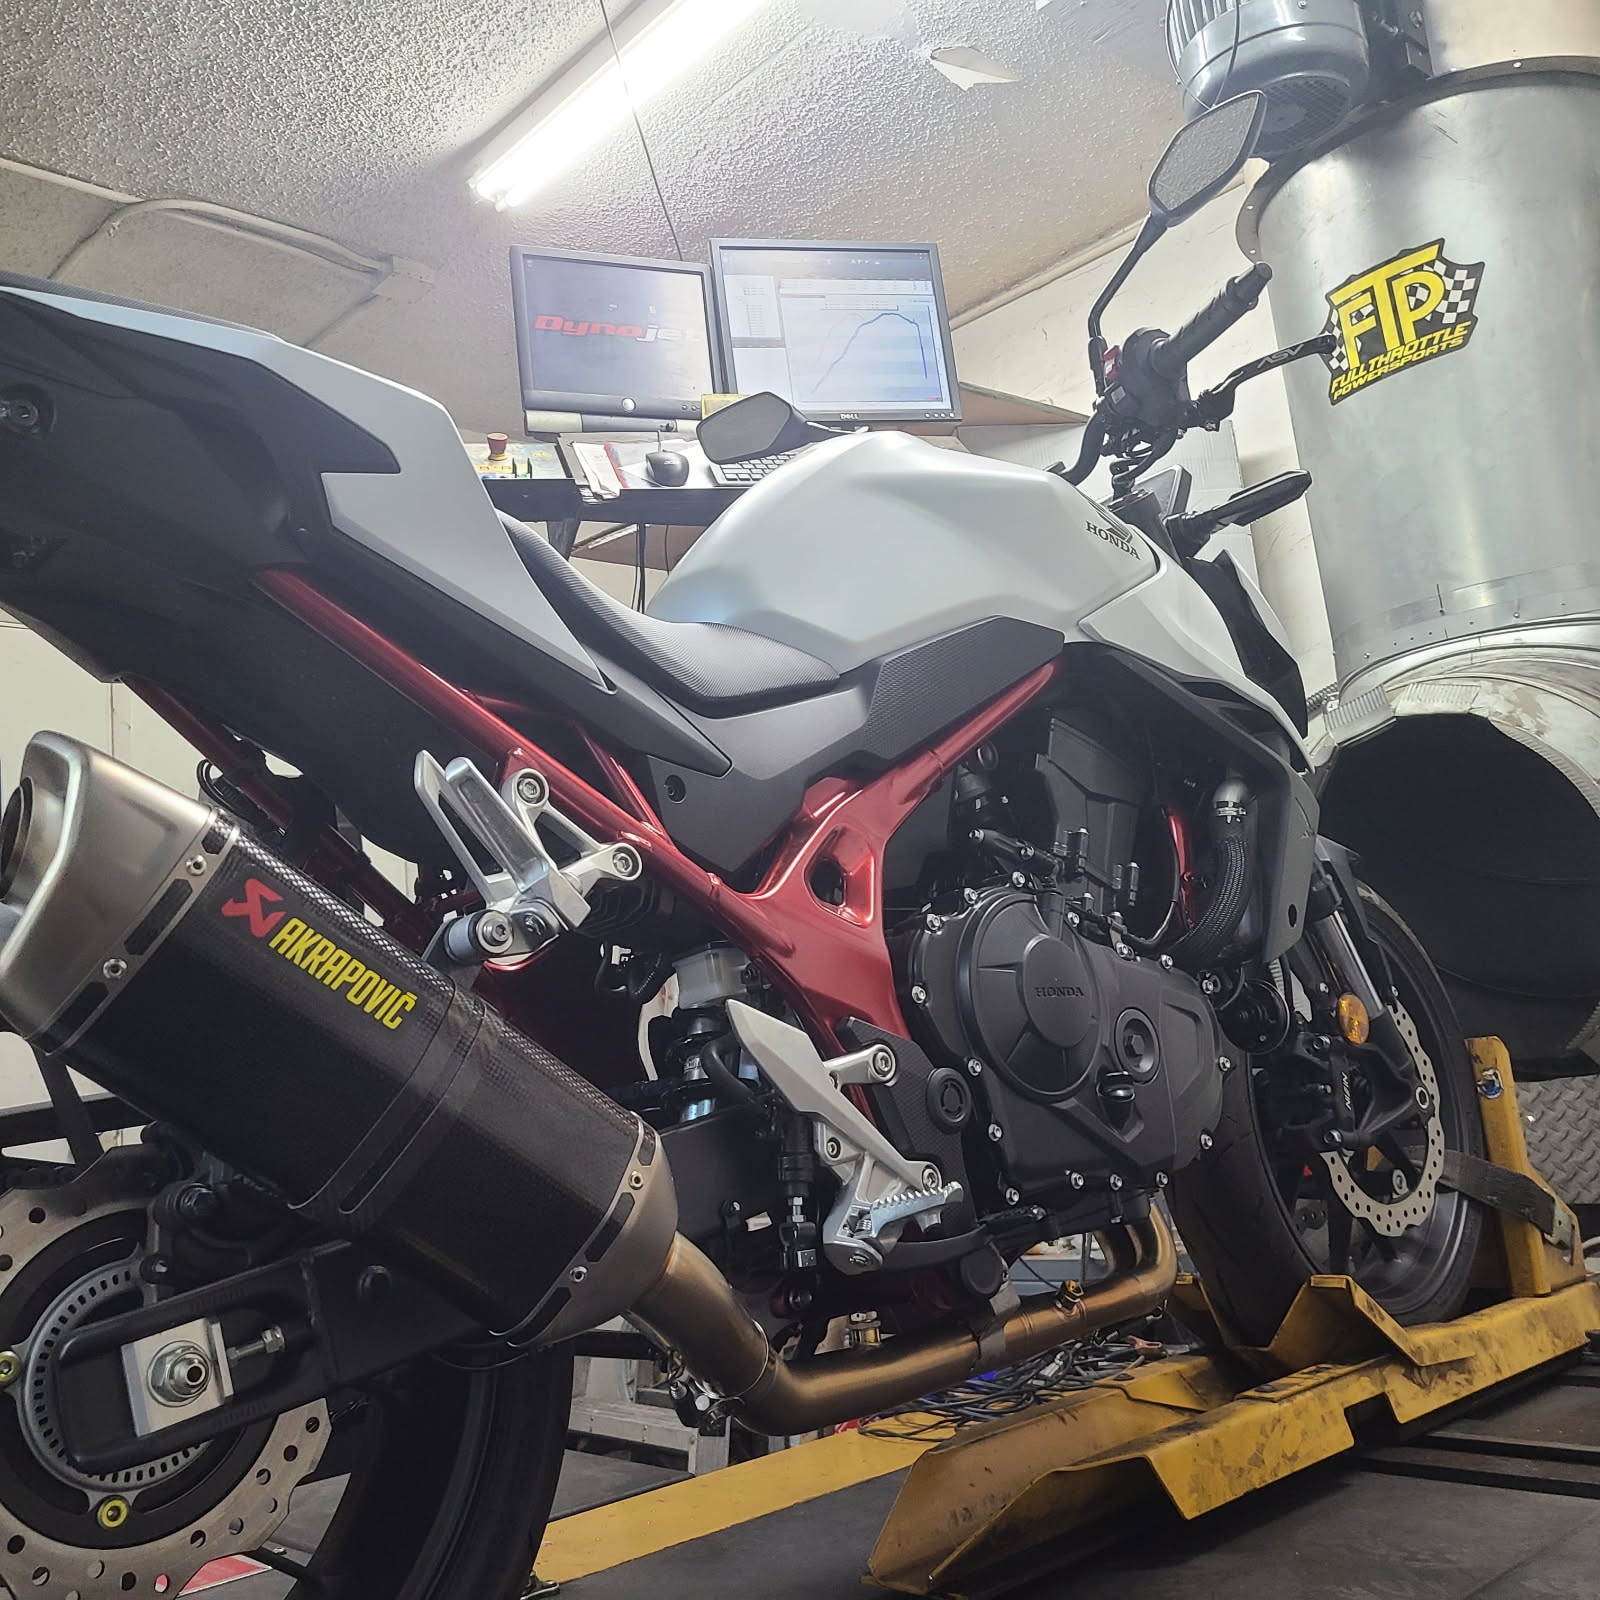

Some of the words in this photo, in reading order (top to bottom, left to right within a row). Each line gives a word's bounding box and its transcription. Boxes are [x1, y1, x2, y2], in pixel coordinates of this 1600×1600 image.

[1329, 244, 1446, 370] FTP
[1331, 362, 1368, 394] FULL
[1367, 321, 1472, 372] THROTTLE
[1333, 335, 1464, 401] POWERSPORTS
[1085, 520, 1141, 561] HONDA
[1034, 985, 1085, 998] HONDA
